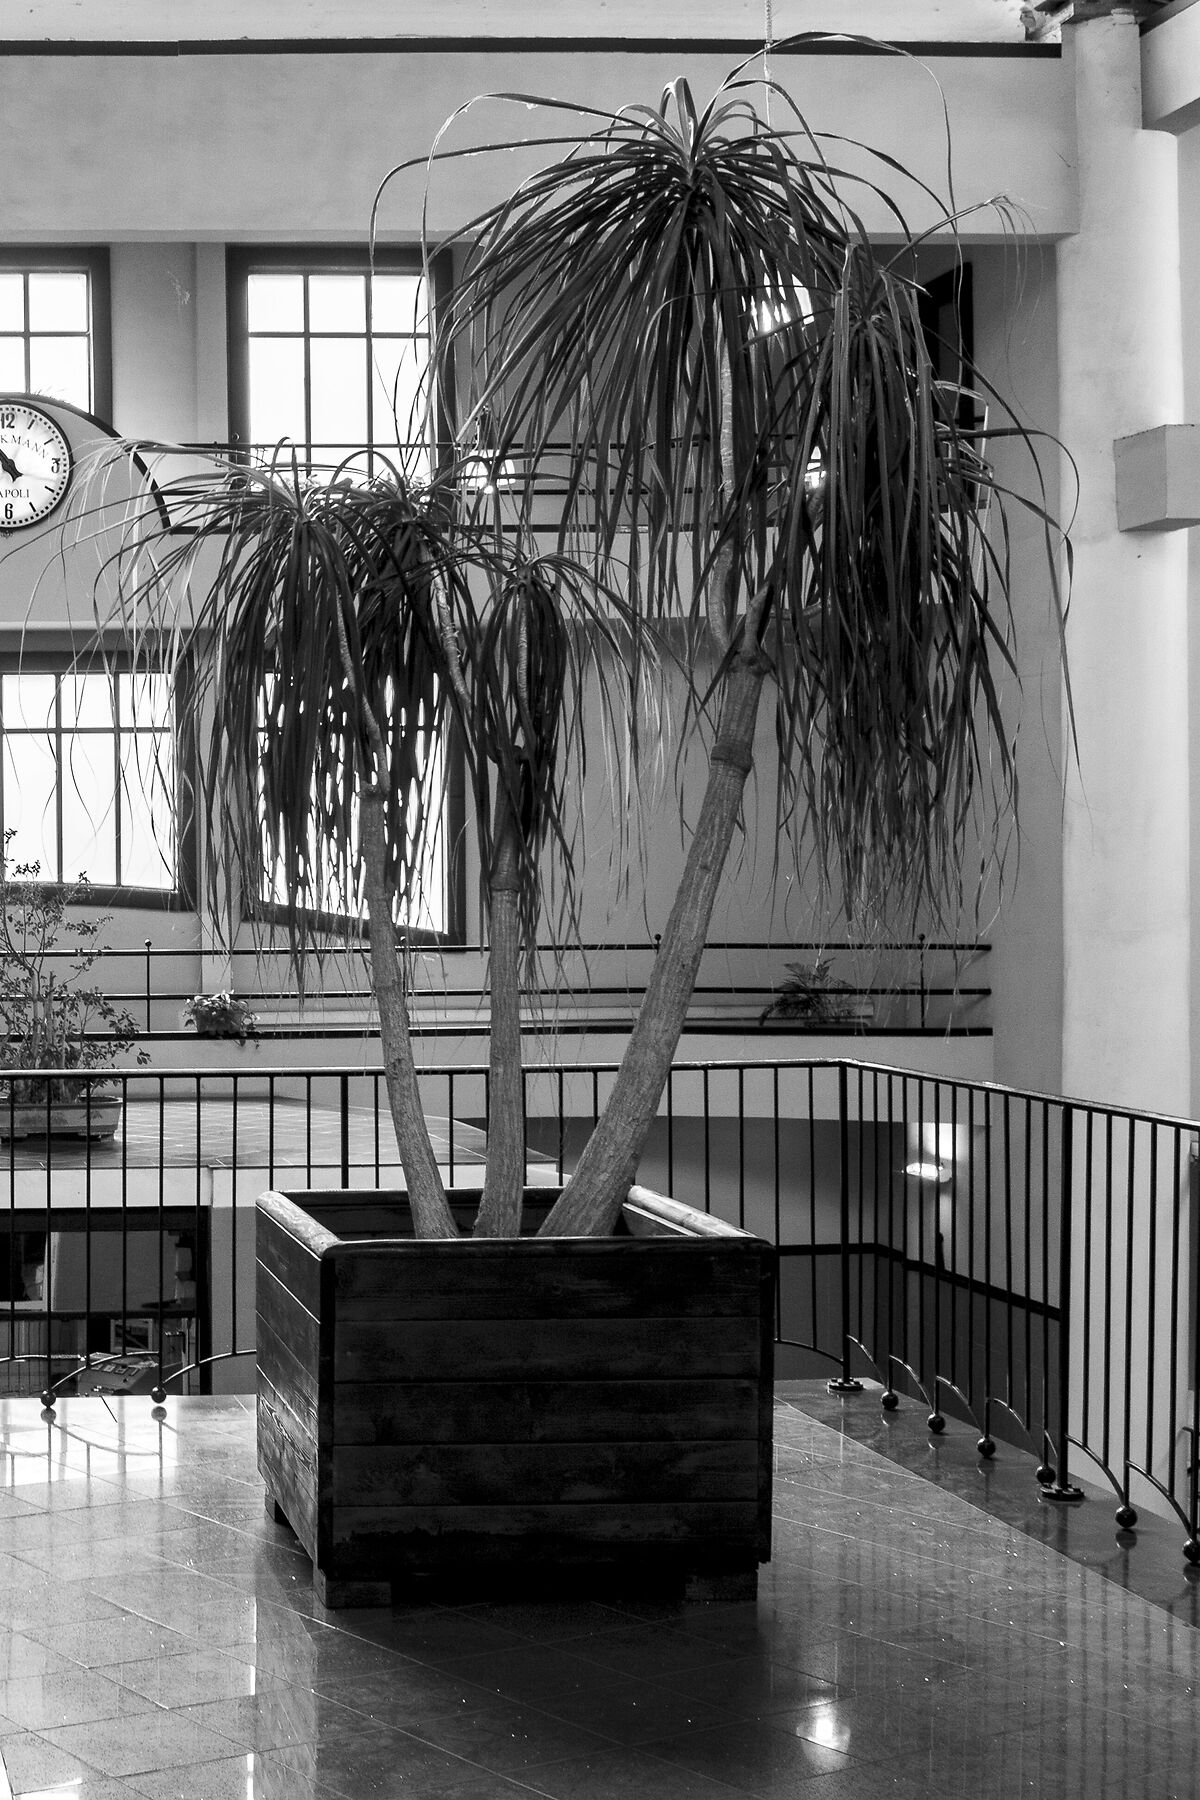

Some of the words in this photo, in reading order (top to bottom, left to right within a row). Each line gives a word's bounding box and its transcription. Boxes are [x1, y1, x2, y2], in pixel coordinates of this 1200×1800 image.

[0, 412, 15, 429] 12
[51, 457, 61, 474] 3
[4, 503, 13, 519] 6
